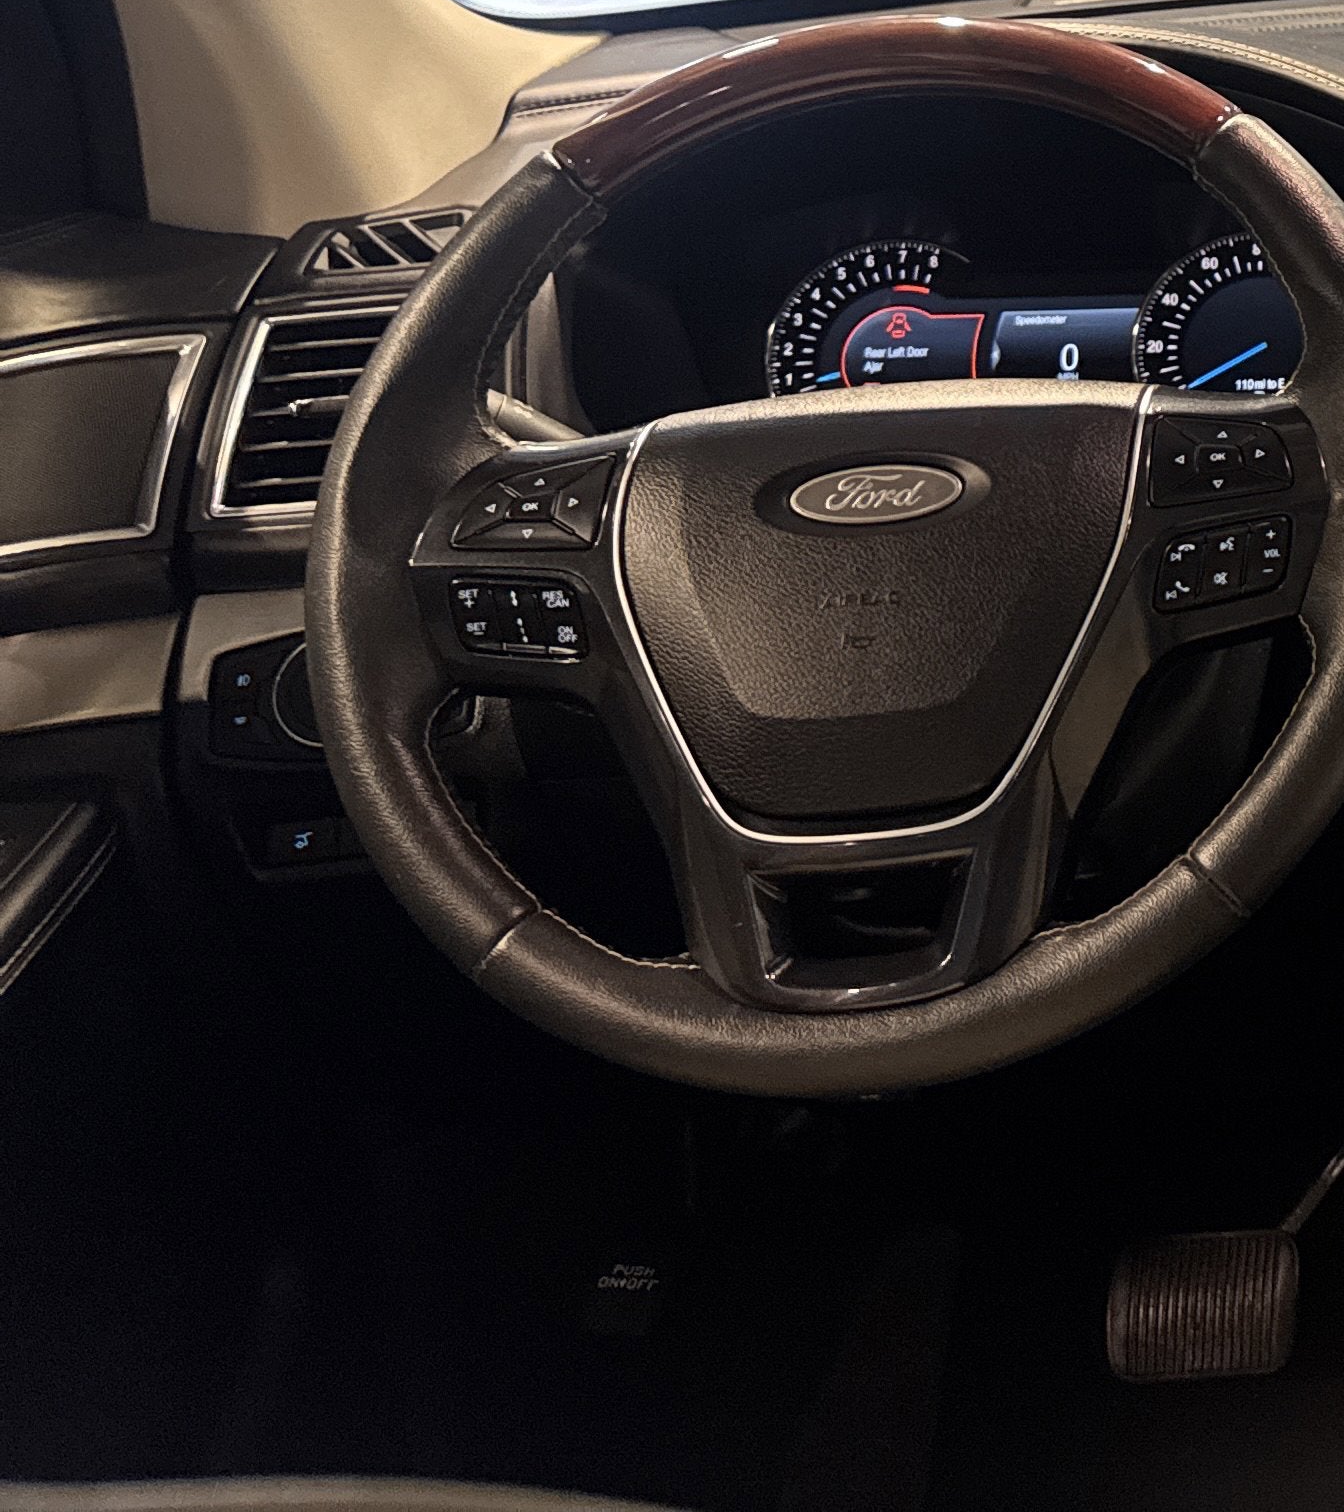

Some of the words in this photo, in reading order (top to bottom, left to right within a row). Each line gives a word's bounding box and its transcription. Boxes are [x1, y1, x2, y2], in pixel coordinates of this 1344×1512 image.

[864, 254, 875, 268] 6
[898, 250, 908, 264] 7
[928, 255, 939, 268] 8
[1201, 256, 1219, 270] 60
[837, 266, 847, 281] 5
[810, 287, 821, 301] 4
[1161, 292, 1179, 306] 40
[793, 312, 803, 327] 3
[1015, 314, 1068, 327] Speedometer
[783, 341, 794, 356] 2
[863, 346, 887, 359] Rear
[888, 346, 906, 358] Left
[907, 345, 929, 358] Door
[1146, 339, 1163, 354] 20
[1059, 343, 1080, 371] 0
[862, 361, 884, 375] Ajar
[785, 373, 793, 386] 1
[1210, 452, 1227, 462] OK
[825, 473, 927, 511] Ford
[521, 502, 539, 512] OK
[1263, 548, 1281, 559] VOL
[458, 588, 479, 600] SET
[546, 599, 570, 609] CAN
[466, 621, 487, 633] SET
[558, 625, 574, 634] ON
[558, 633, 578, 643] OFF
[613, 1263, 656, 1276] PUSH
